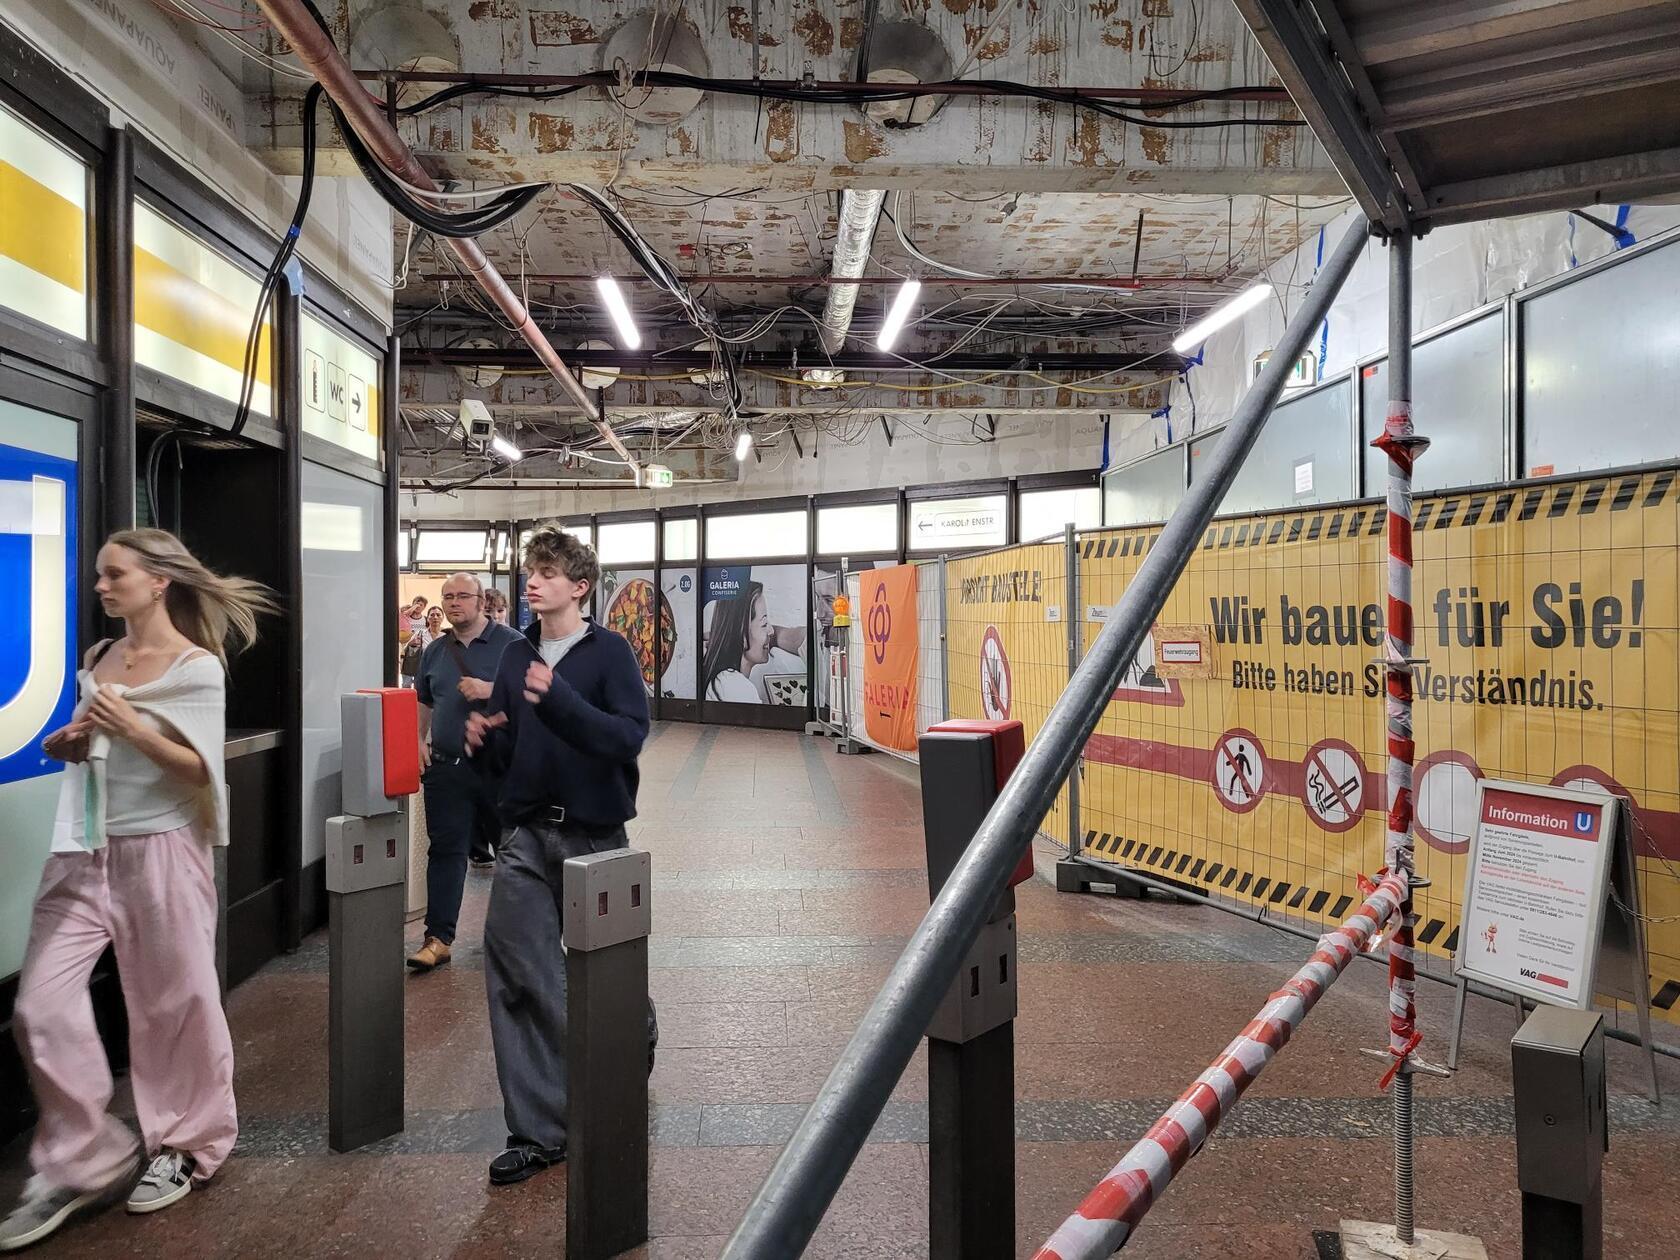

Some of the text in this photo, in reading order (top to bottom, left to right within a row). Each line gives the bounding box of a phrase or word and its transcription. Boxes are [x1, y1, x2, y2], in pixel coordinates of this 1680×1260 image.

[88, 0, 175, 75] AQUAPAN
[330, 380, 344, 405] WC
[941, 516, 994, 529] KAROLENSTR
[709, 580, 740, 590] GALERIA
[1210, 578, 1645, 649] Wir baue für Sie!
[1232, 660, 1604, 711] Bitte haben Si Verständnis.
[1488, 805, 1592, 831] Information U
[1520, 968, 1536, 979] VAG
